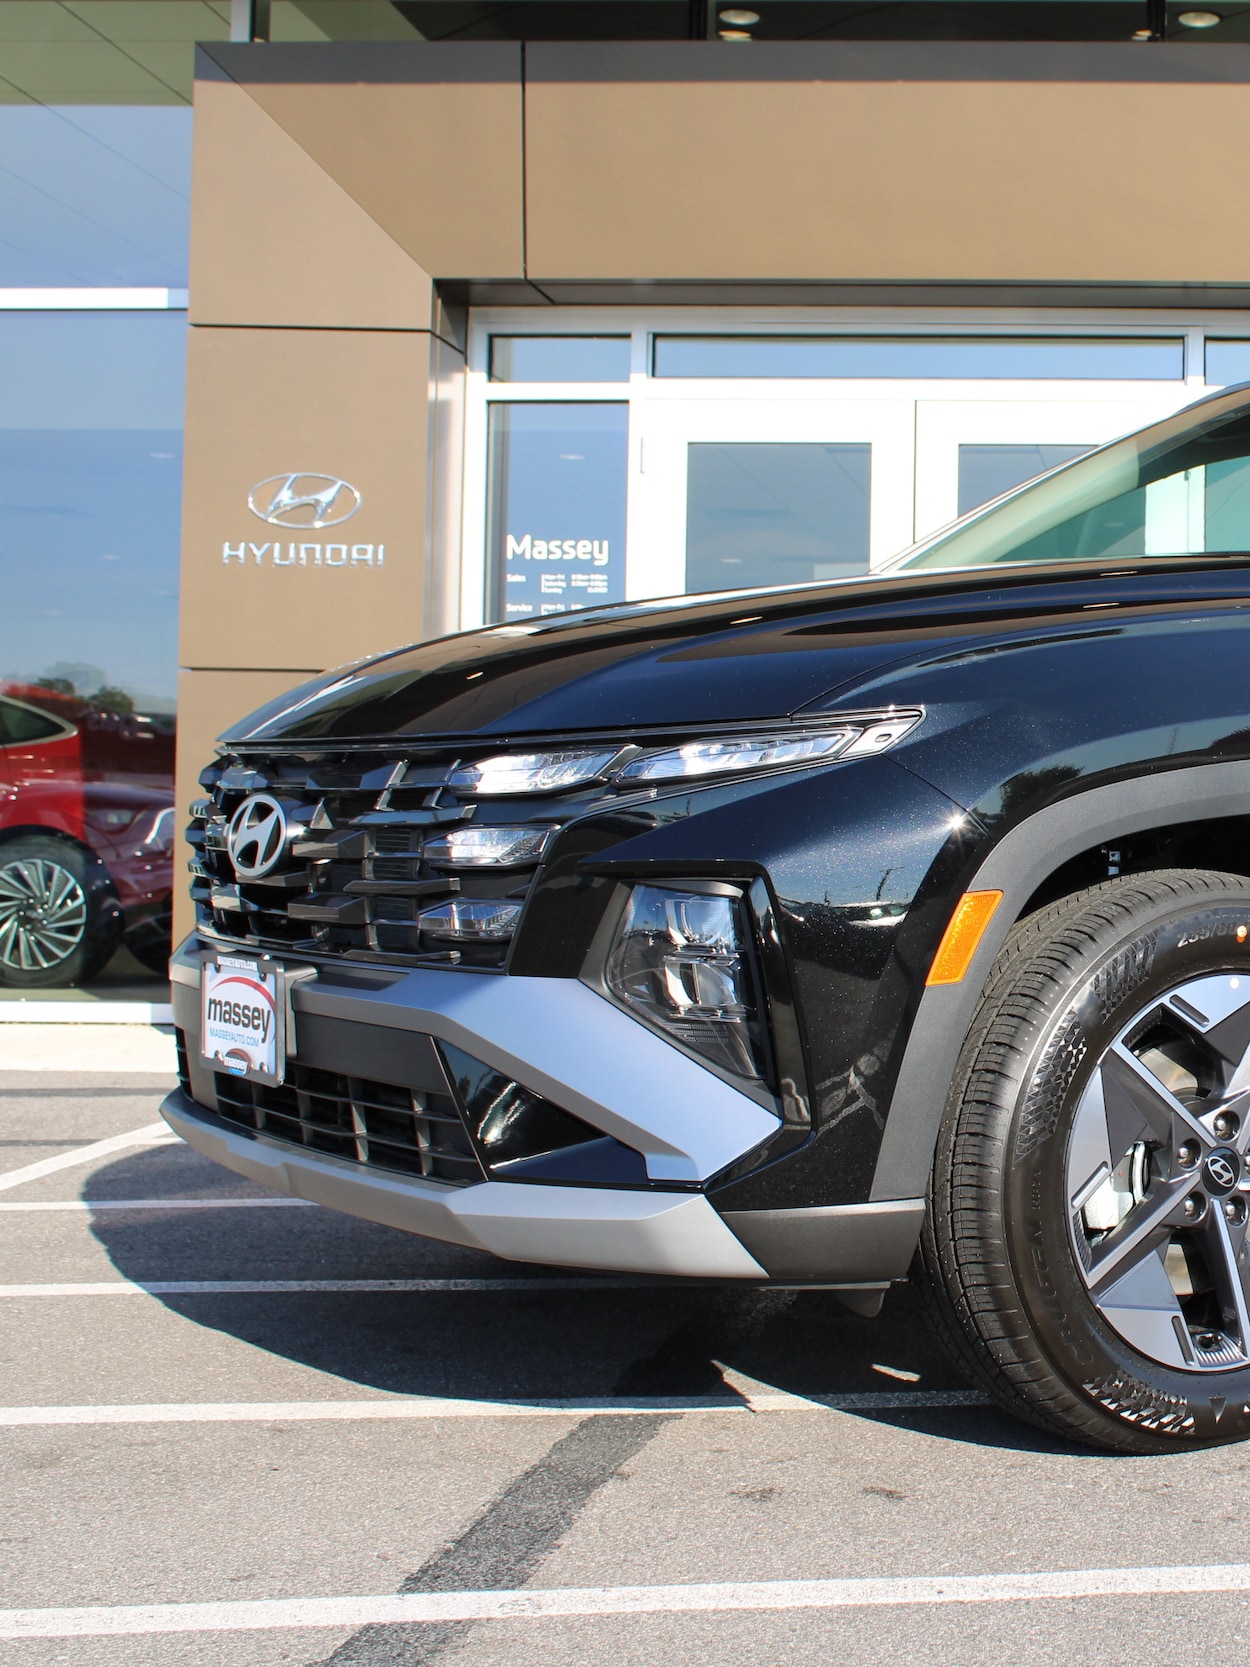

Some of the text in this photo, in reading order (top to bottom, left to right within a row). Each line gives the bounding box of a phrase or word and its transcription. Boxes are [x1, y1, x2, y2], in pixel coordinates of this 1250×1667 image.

[221, 541, 385, 568] HYUNDAI
[506, 534, 609, 566] Massey
[506, 573, 526, 582] Sales
[505, 603, 533, 612] Service
[207, 997, 271, 1044] massey
[209, 1026, 260, 1048] MASSEYAUTO.COM
